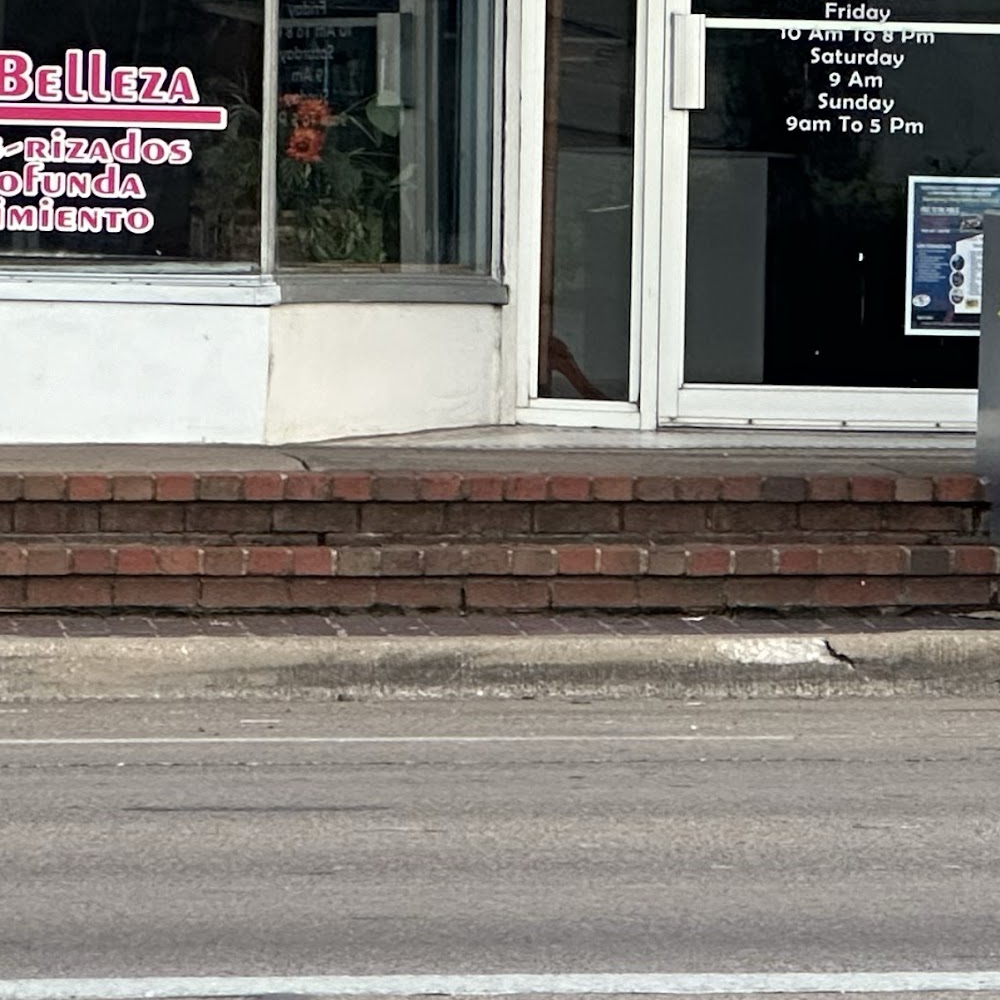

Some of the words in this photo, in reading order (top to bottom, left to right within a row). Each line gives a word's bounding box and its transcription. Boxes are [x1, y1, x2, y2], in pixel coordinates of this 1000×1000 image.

[825, 2, 891, 23] Friday
[781, 28, 801, 41] 10
[808, 28, 843, 42] Am
[853, 30, 875, 43] To
[882, 30, 894, 44] 8
[901, 31, 935, 45] Pm
[810, 47, 905, 69] Saturday
[828, 72, 841, 88] 9
[848, 71, 883, 88] Am
[818, 92, 895, 114] Sunday
[786, 115, 831, 132] 9am
[838, 116, 863, 133] To
[869, 118, 881, 134] 5
[890, 117, 924, 135] Pm
